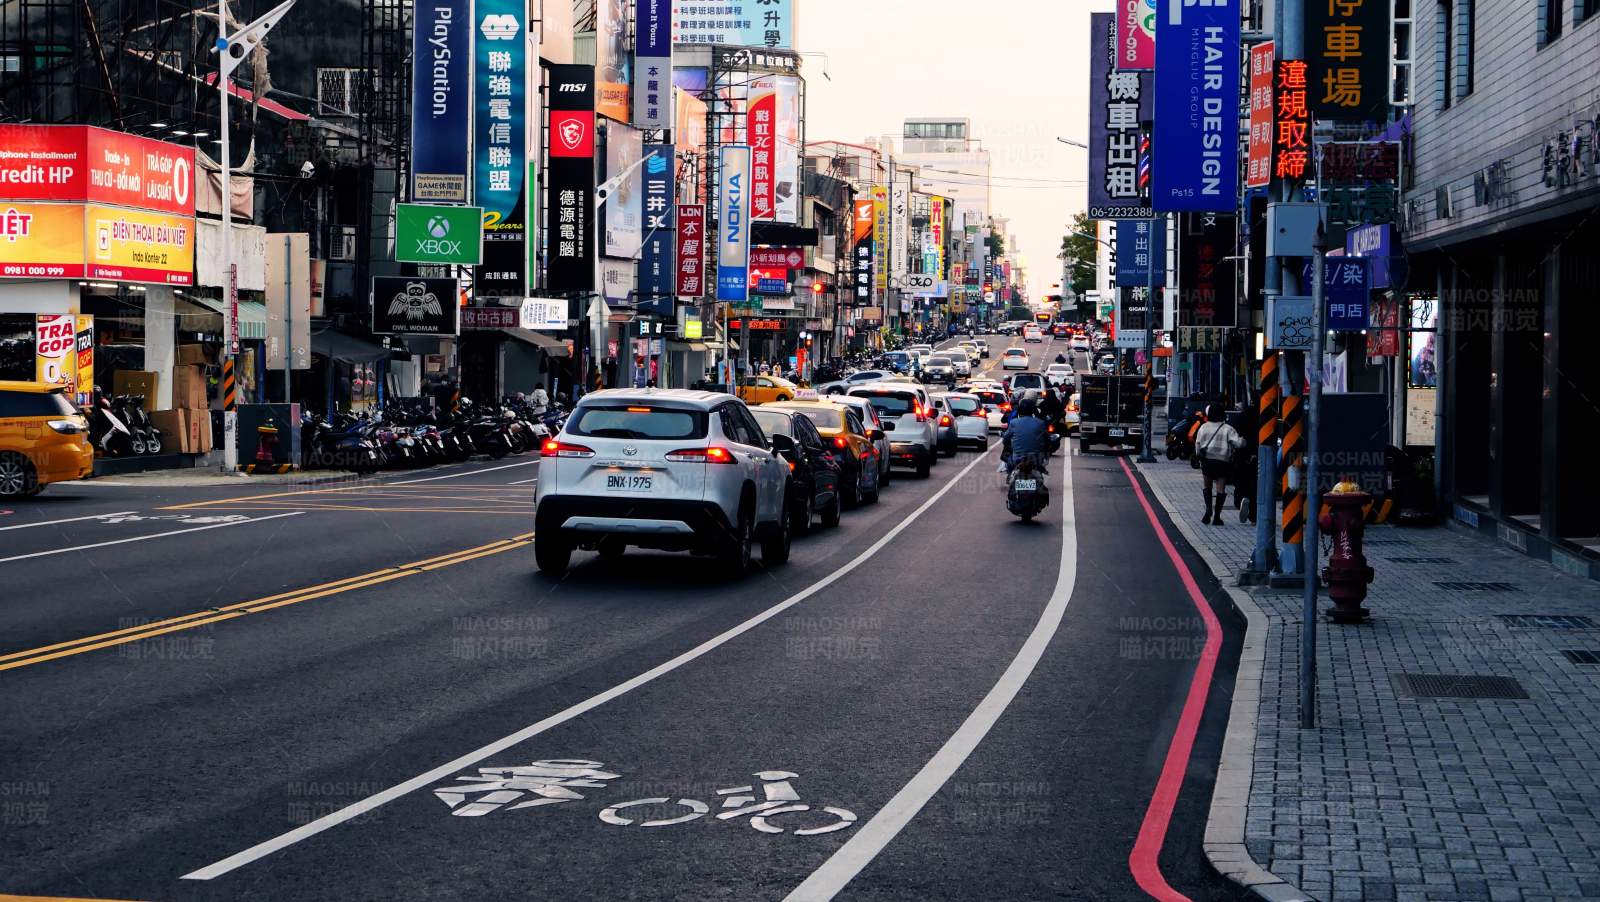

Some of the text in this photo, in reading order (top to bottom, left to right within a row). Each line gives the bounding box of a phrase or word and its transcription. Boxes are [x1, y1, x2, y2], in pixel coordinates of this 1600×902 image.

[559, 83, 587, 92] msi
[1190, 28, 1200, 129] MINGLIU GROUP
[1204, 26, 1223, 91] HAIR
[488, 51, 512, 192] 聯強電信聯盟
[647, 66, 659, 119] 本龍電通
[1249, 53, 1263, 181] 違規停車
[1276, 60, 1308, 179] 違規取締
[1106, 69, 1140, 199] 機車出租
[1201, 98, 1222, 195] DESIGN
[0, 164, 74, 184] redit HP
[559, 189, 575, 257] 德源電腦
[728, 173, 741, 242] NOKIA
[1091, 207, 1152, 217] 06-2232388
[4, 266, 65, 275] 0981 000 999
[415, 239, 462, 256] XBOX
[680, 221, 700, 293] 本龍電通
[1135, 222, 1148, 267] 車出租
[1330, 303, 1362, 318] 門店
